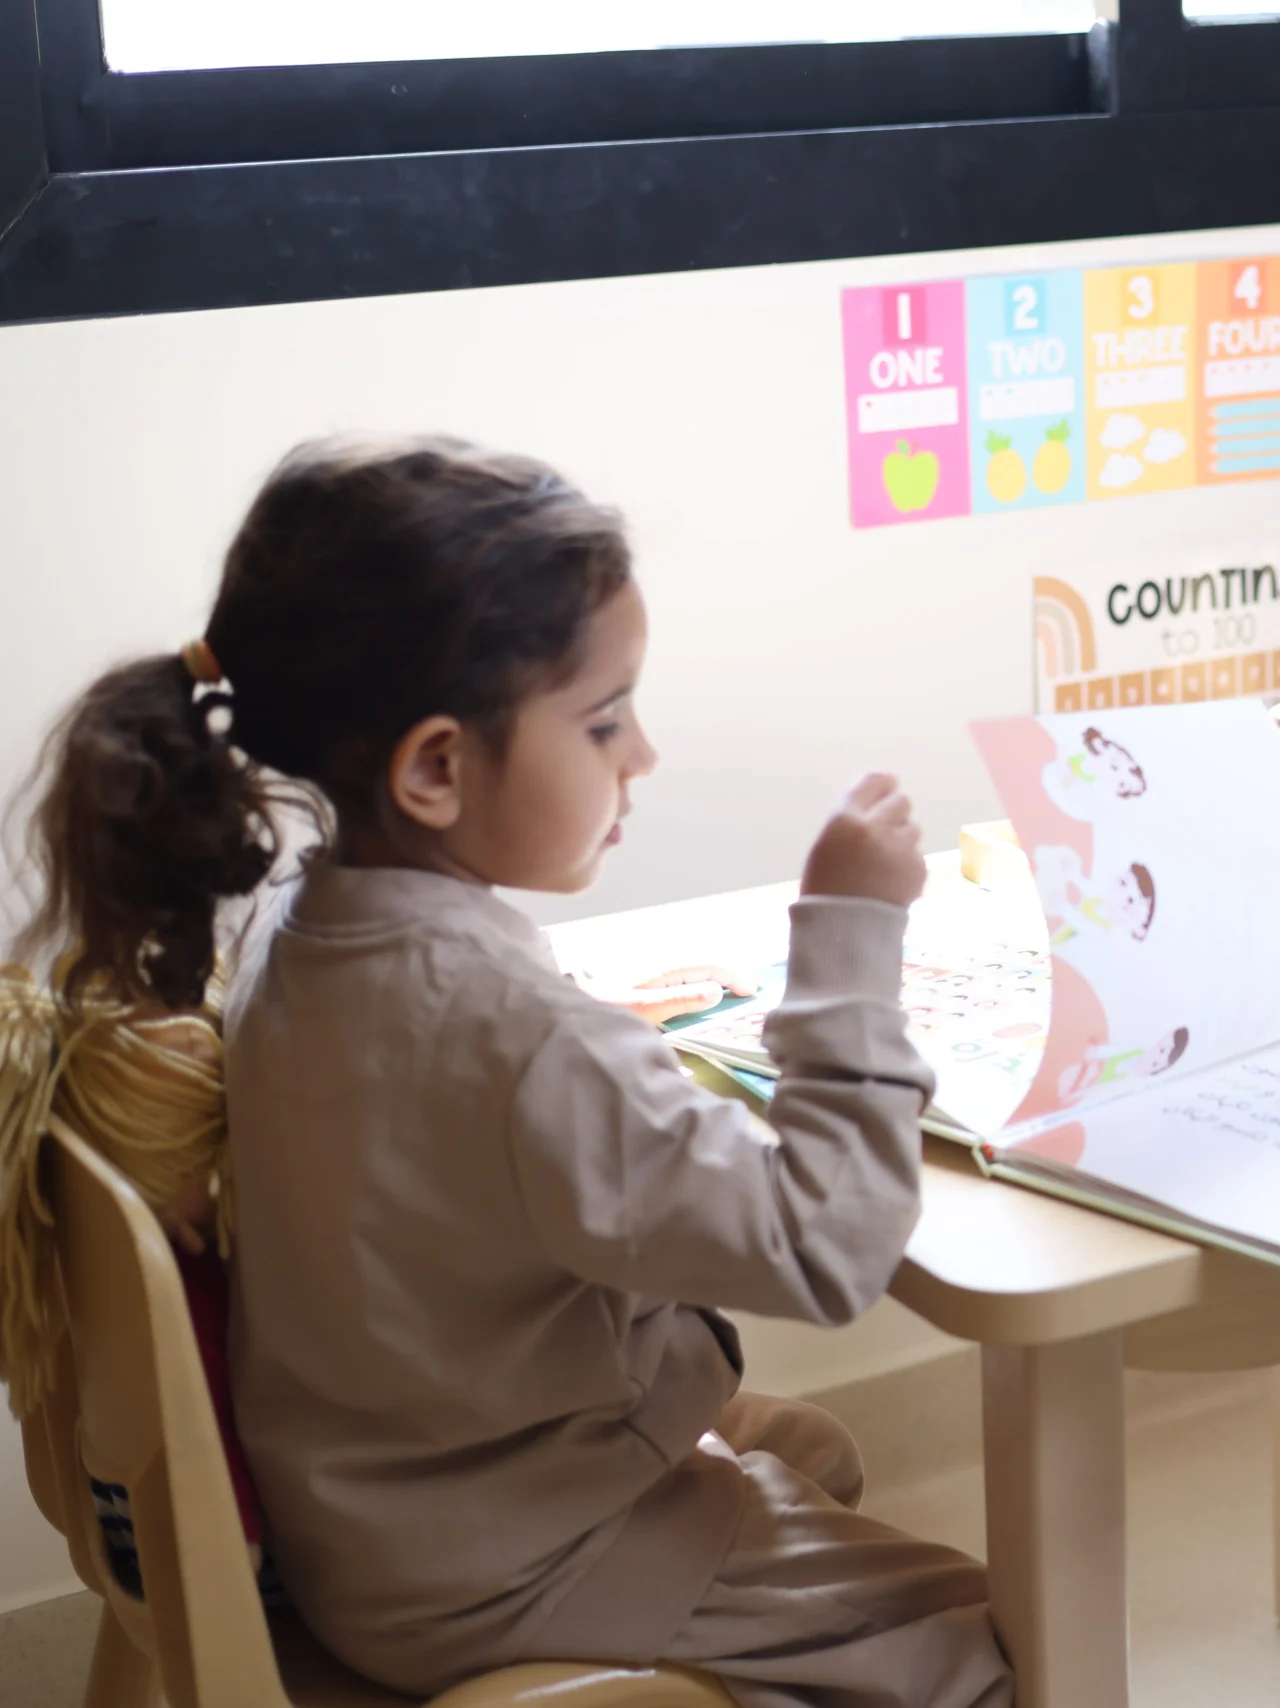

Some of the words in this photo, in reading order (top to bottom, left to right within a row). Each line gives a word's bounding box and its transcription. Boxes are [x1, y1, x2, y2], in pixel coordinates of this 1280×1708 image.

[1013, 285, 1039, 330] 2
[1127, 275, 1154, 319] 3
[1234, 265, 1261, 310] 4
[897, 292, 912, 340] 1
[869, 347, 944, 389] ONE
[987, 338, 1067, 377] TWO
[1091, 325, 1188, 367] THREE
[1161, 627, 1200, 658] to
[1212, 613, 1257, 651] 100
